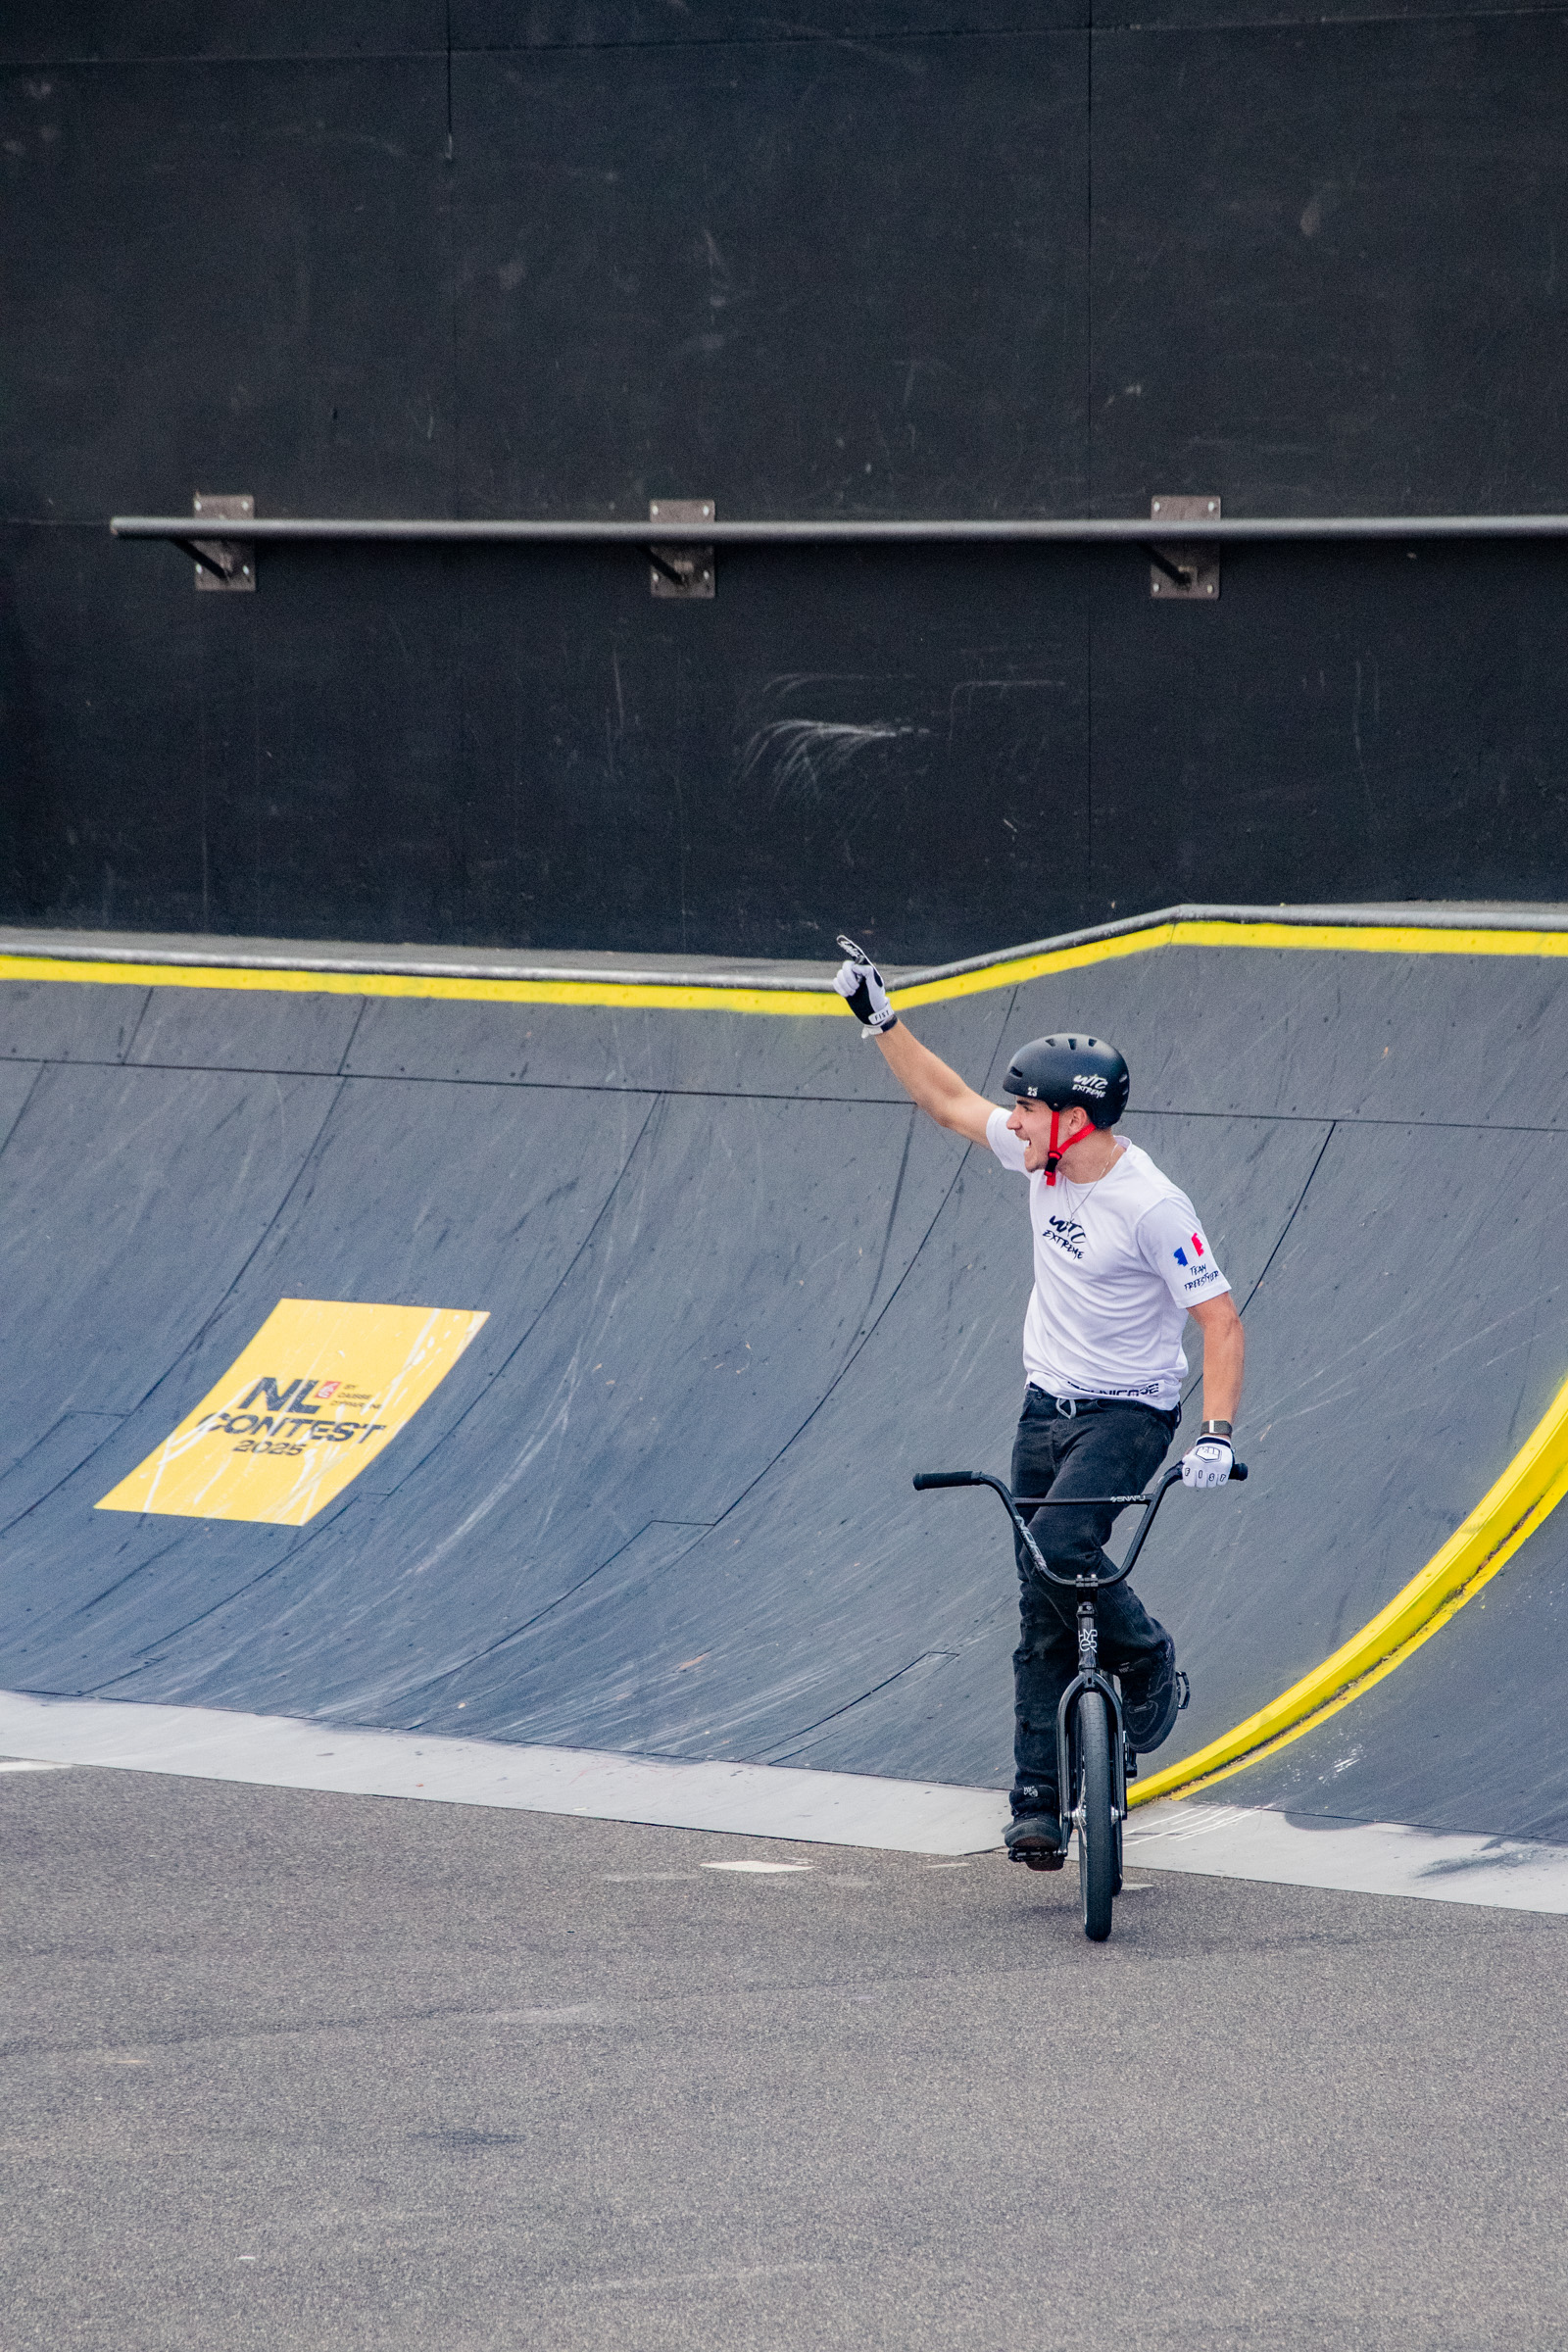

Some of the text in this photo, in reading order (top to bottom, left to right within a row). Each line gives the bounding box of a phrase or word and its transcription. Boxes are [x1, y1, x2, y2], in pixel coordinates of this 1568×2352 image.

[874, 1010, 890, 1021] FIST
[1072, 1084, 1106, 1099] EXTREME
[1042, 1229, 1085, 1260] EXTREME
[1190, 1263, 1206, 1276] TEAM
[237, 1377, 321, 1414] NL
[198, 1412, 386, 1445] CONTEST
[232, 1440, 307, 1456] 2025
[1184, 1467, 1227, 1483] FIST
